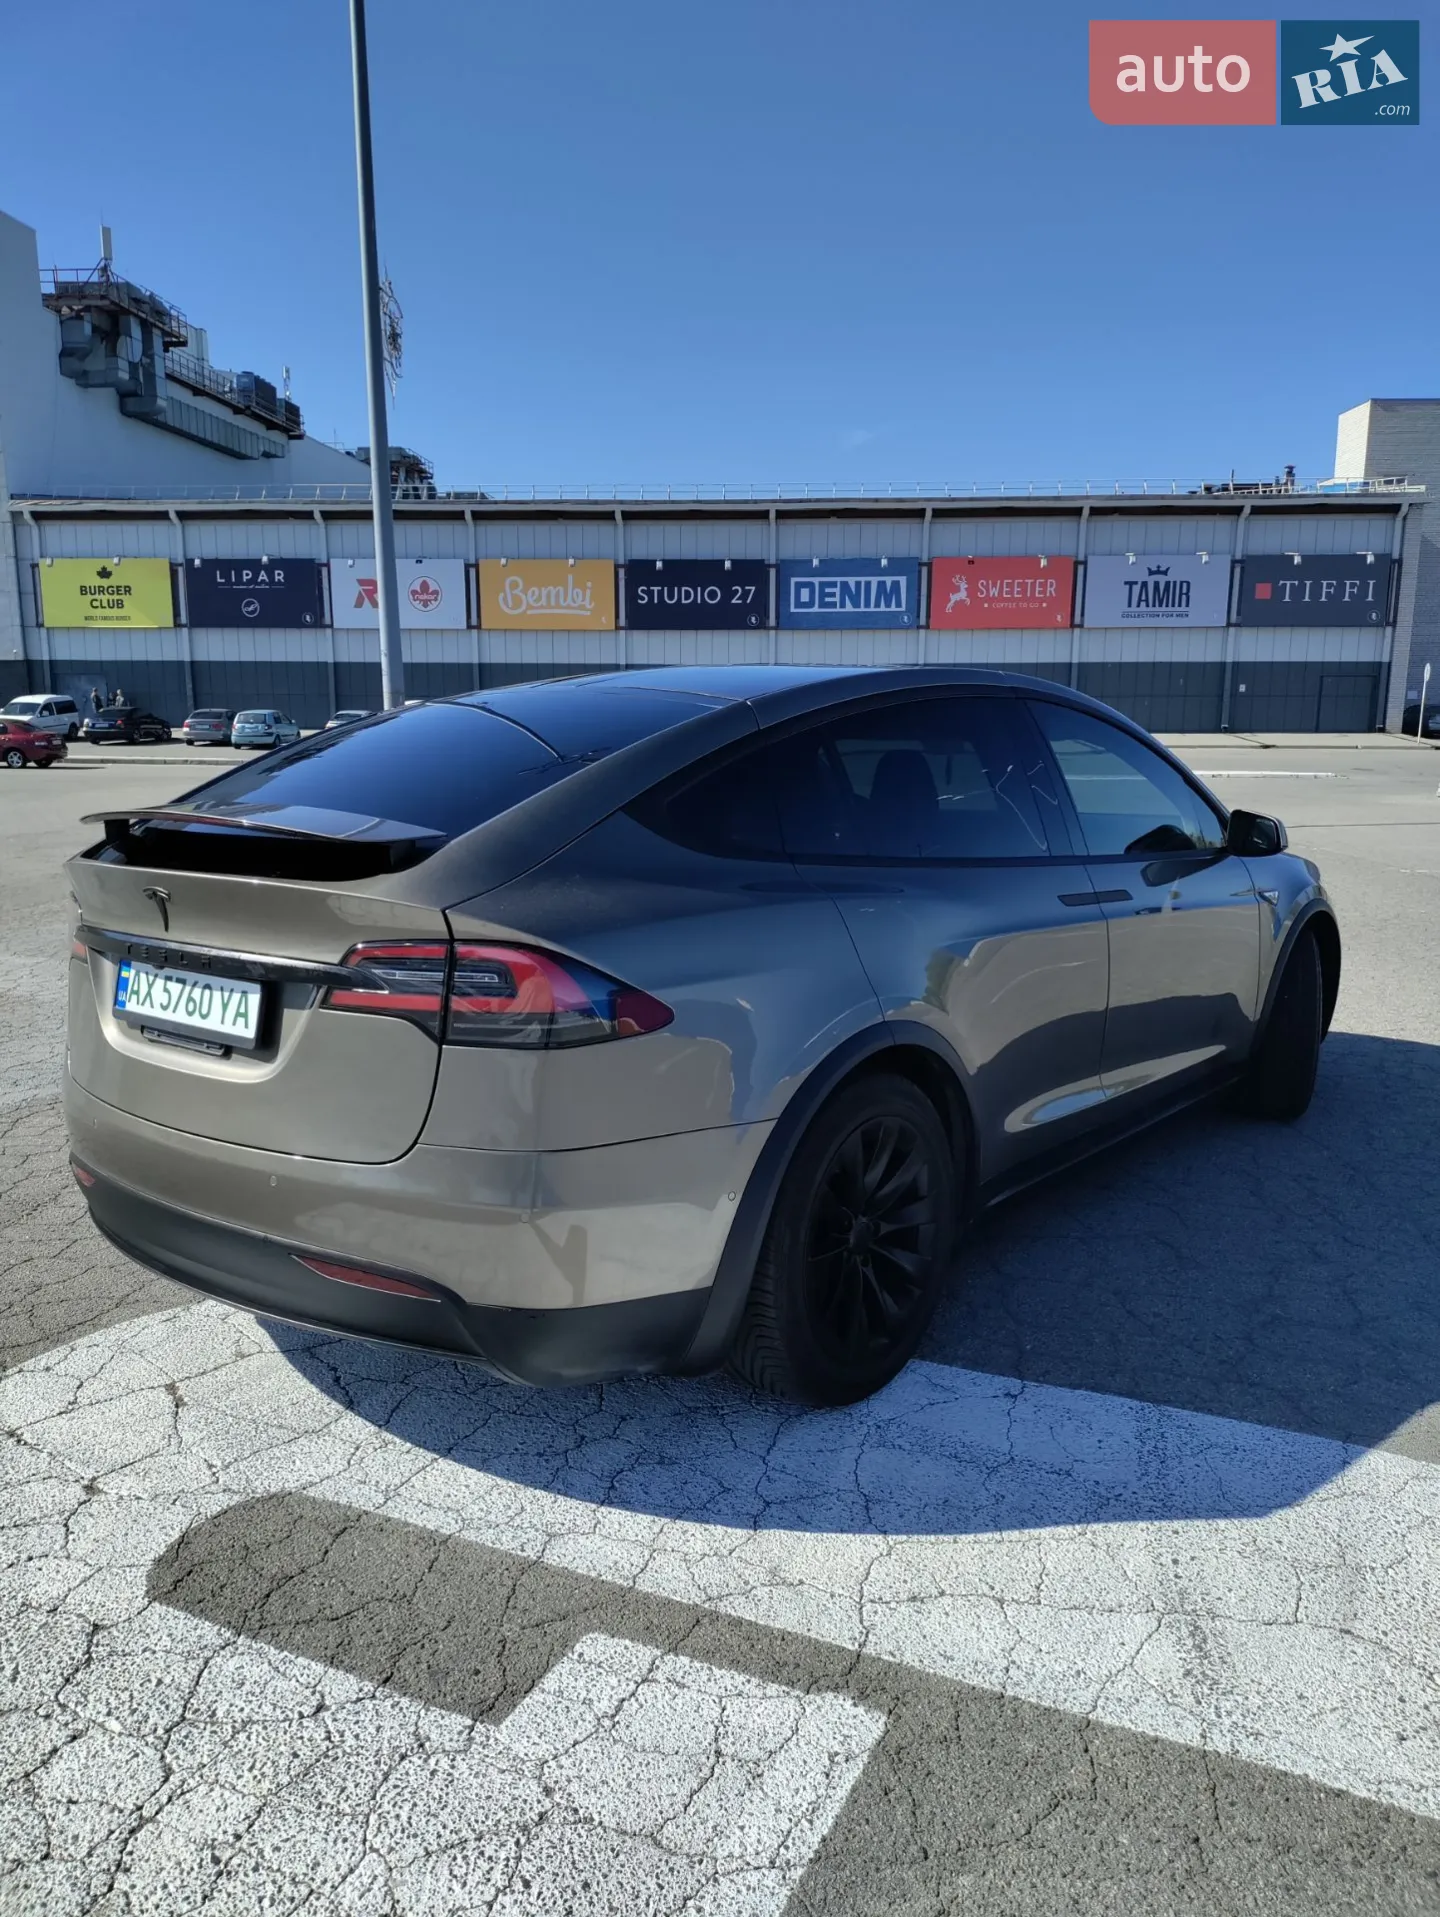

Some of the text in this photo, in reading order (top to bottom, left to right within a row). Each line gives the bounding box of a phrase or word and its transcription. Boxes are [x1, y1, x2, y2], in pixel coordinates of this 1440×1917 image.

[216, 570, 285, 583] LIPAR
[79, 585, 133, 596] BURGER
[498, 574, 595, 614] Bembi
[637, 586, 756, 604] STUDIO 27
[793, 579, 905, 610] DENIM
[977, 579, 1057, 598] SWEETER
[1123, 580, 1191, 608] TAMIR
[1278, 580, 1377, 602] TIFFI
[90, 598, 125, 609] CLUB
[127, 969, 250, 1029] AX 5760 YA
